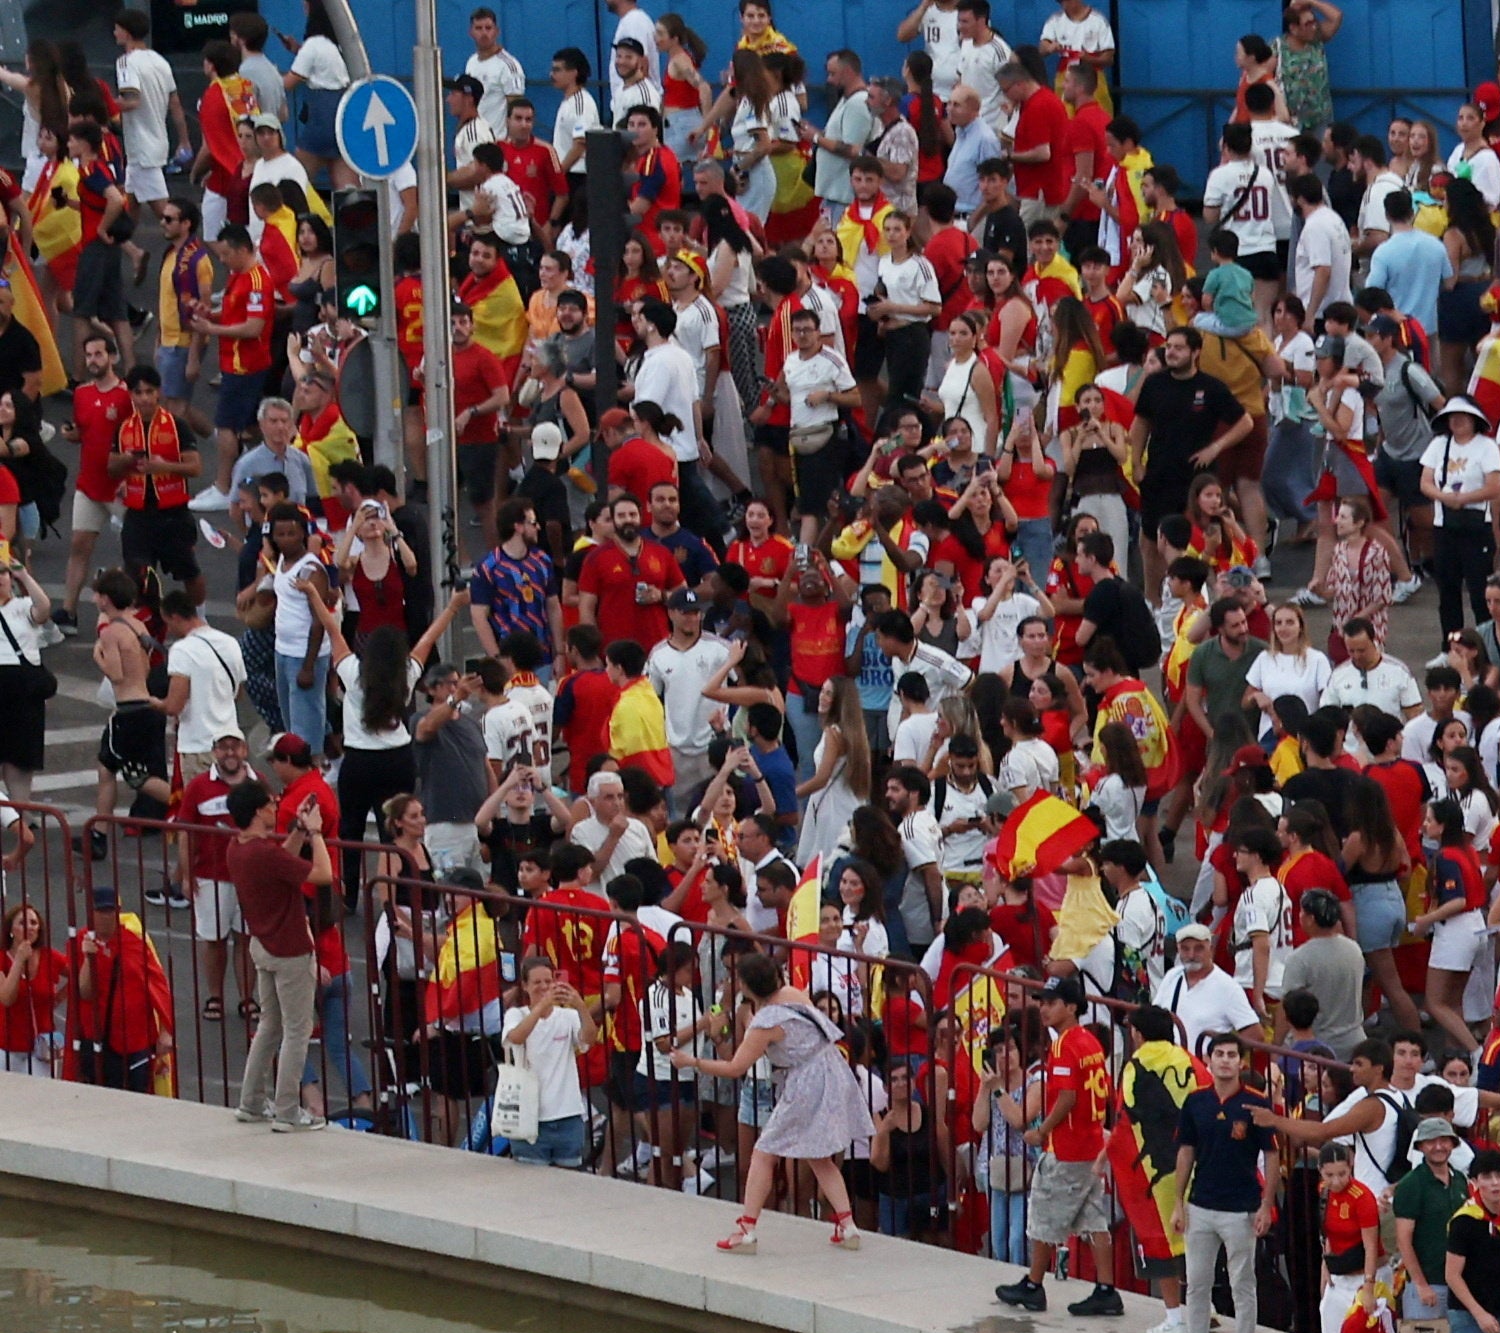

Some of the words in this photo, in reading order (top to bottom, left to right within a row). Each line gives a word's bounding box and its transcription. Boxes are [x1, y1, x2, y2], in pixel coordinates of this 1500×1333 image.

[194, 14, 228, 25] MADRID
[926, 27, 940, 43] 19
[1235, 187, 1268, 221] 20
[861, 668, 892, 687] BRO
[1085, 1070, 1107, 1121] 19
